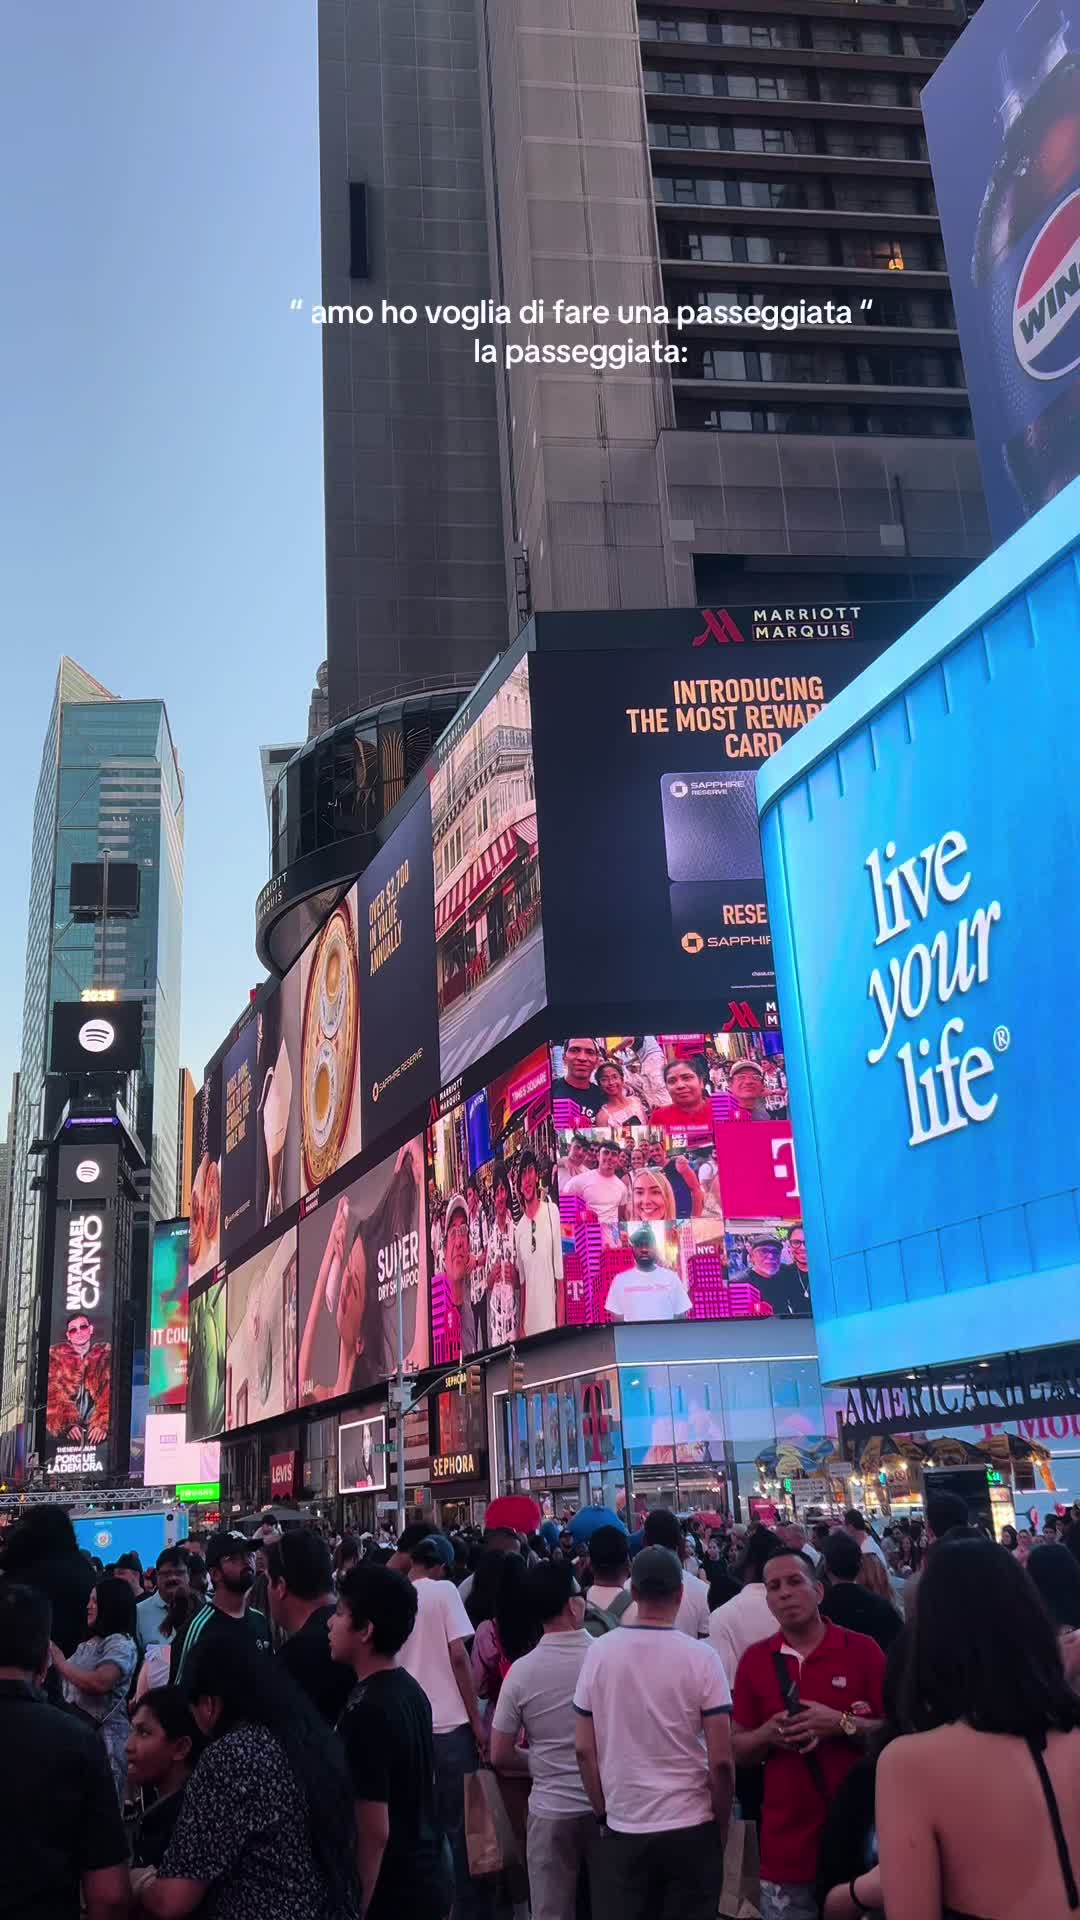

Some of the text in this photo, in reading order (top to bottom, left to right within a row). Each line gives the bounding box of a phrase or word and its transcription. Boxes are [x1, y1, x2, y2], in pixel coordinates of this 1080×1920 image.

[1019, 262, 1080, 345] WIN
[753, 606, 861, 622] MARRIOTT
[755, 623, 851, 639] MARQUIS
[672, 676, 824, 705] INTRODUCING
[625, 703, 829, 734] THE MOST REWAR
[724, 732, 783, 758] CARD
[690, 780, 745, 790] SAPPHIRE
[690, 788, 729, 796] RESERVE
[864, 829, 972, 946] live
[368, 889, 385, 926] OVER
[722, 903, 768, 925] RESE
[369, 899, 398, 952] IN VALUE
[369, 919, 402, 977] ANNUALLY
[866, 899, 1001, 1066] your
[439, 1077, 464, 1102] MARRIOTT
[511, 1071, 547, 1101] TIMES SQUARE
[440, 1091, 461, 1111] MARQUIS
[66, 1215, 85, 1310] NATANAEL
[80, 1215, 103, 1309] CANO
[377, 1230, 419, 1283] SUPER
[697, 1245, 715, 1255] NYC
[389, 1268, 420, 1296] SHMPOO
[445, 1373, 467, 1388] SEPHORA
[846, 1376, 1015, 1427] AMERICAN
[46, 1461, 104, 1474] LA DEMORA
[55, 1453, 97, 1464] PORQUE
[433, 1454, 475, 1476] SEPHORA
